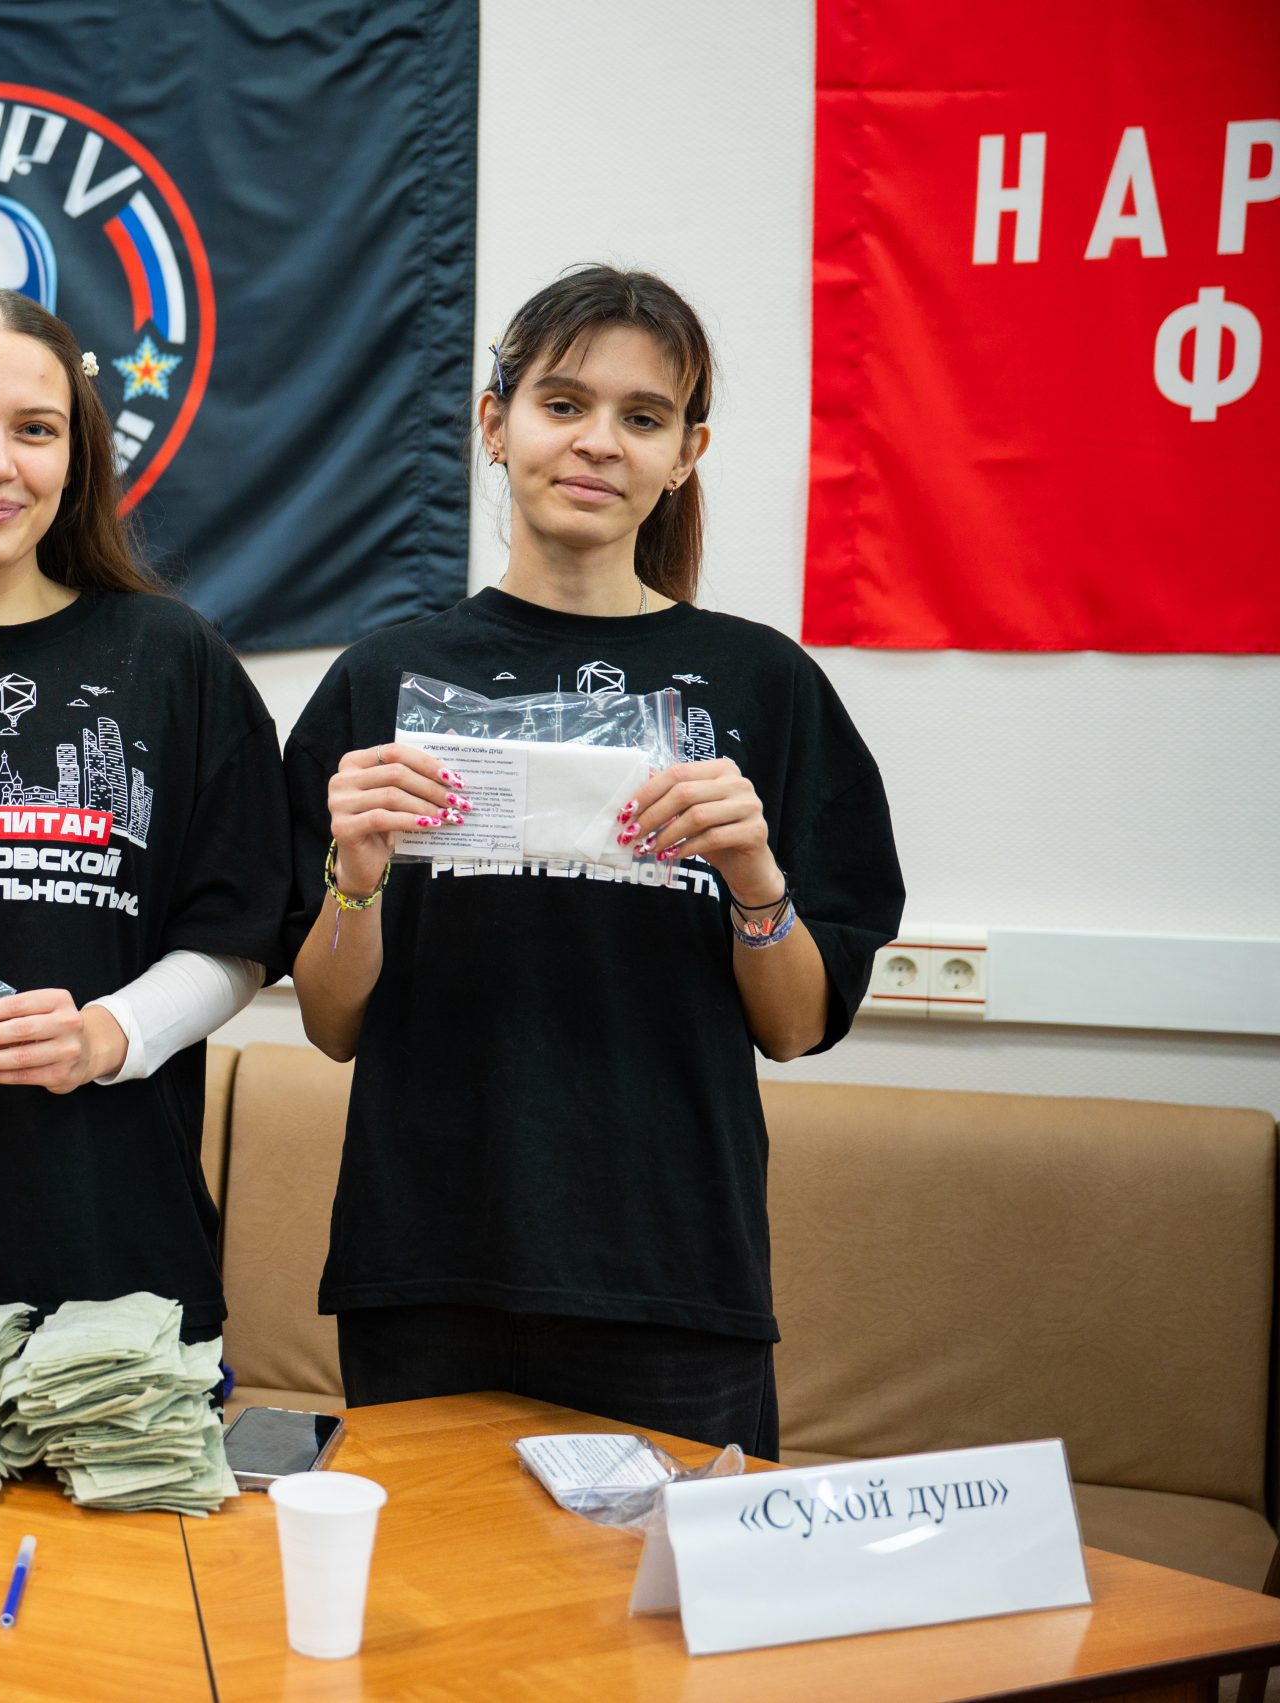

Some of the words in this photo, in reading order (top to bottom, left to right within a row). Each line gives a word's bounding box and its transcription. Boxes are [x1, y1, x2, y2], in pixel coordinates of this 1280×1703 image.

[63, 130, 143, 218] V
[972, 118, 1280, 265] НАР
[1153, 285, 1263, 422] Ф
[738, 1478, 894, 1539] «Сухой
[907, 1478, 1009, 1525] душ»
